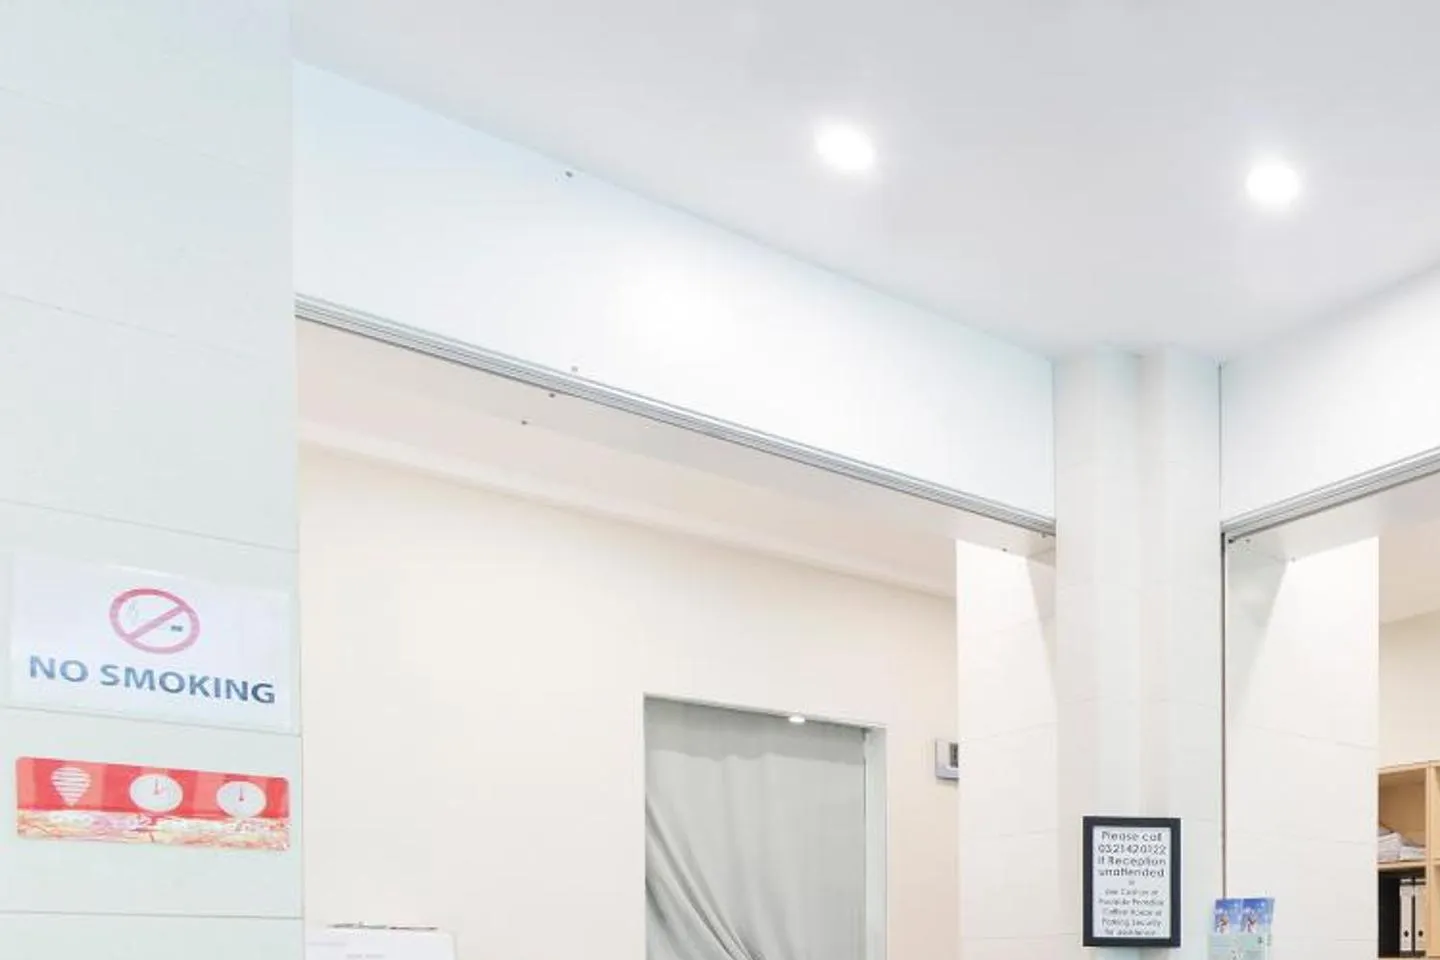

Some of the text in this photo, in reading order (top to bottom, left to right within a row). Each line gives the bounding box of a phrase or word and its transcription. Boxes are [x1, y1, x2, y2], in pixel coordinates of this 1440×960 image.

[29, 655, 275, 704] NO SMOKING
[1101, 831, 1162, 841] Please call
[1108, 856, 1166, 866] Reception
[1098, 868, 1164, 877] unattended
